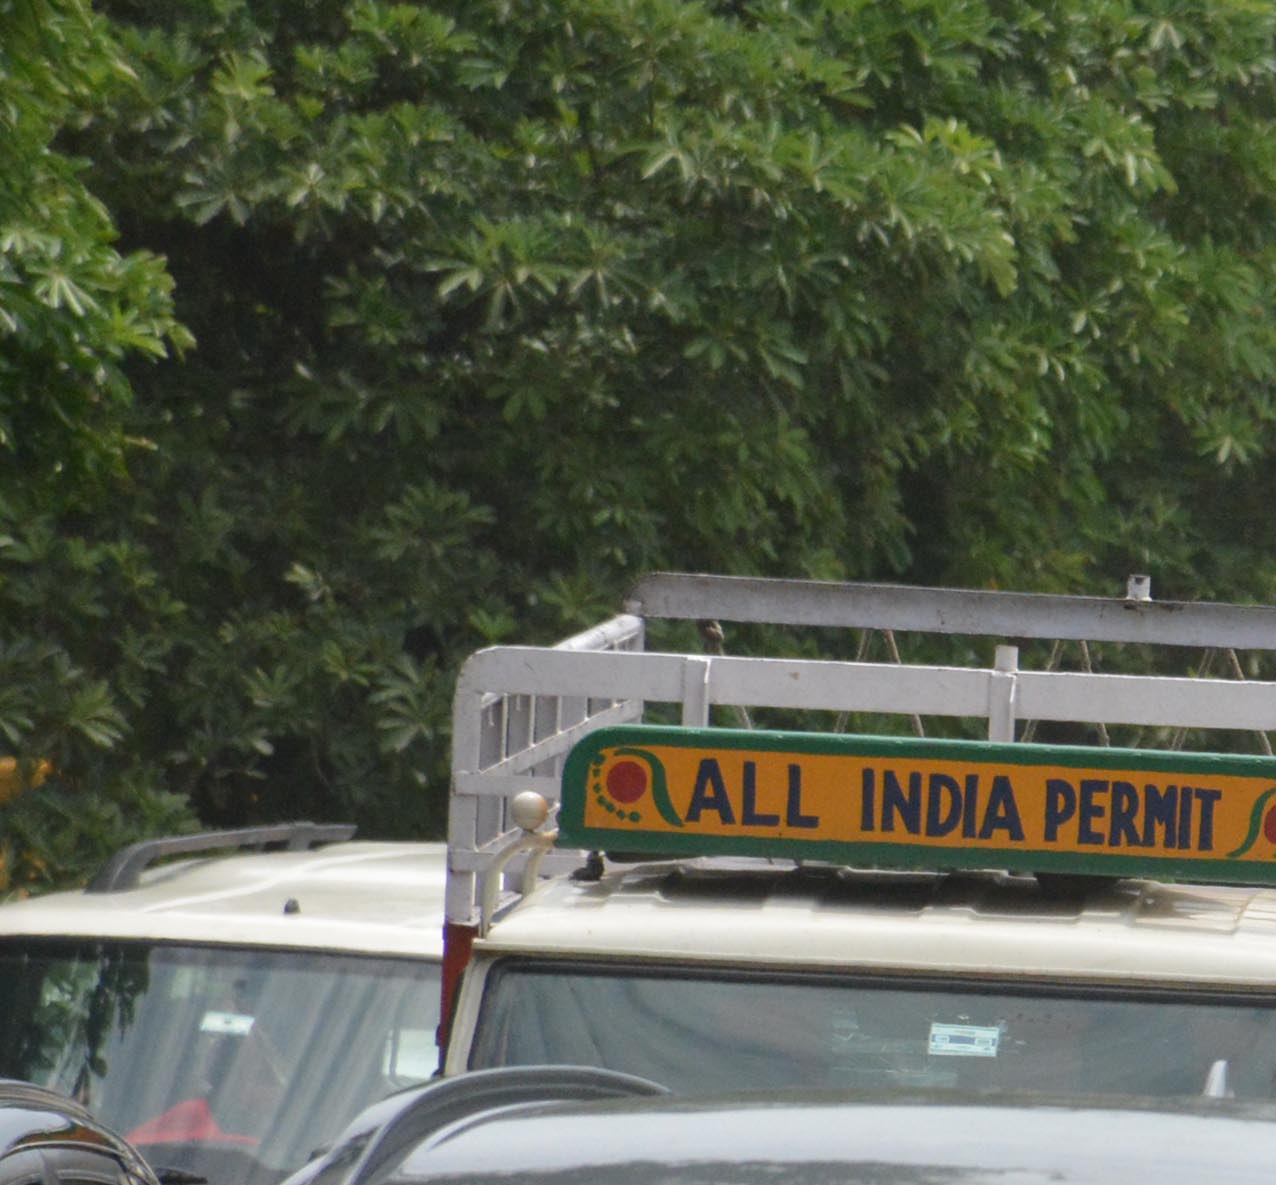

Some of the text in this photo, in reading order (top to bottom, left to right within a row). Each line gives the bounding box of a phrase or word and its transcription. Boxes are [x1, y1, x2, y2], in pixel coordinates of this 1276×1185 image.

[685, 757, 1223, 851] ALL INDIA PERMIT
